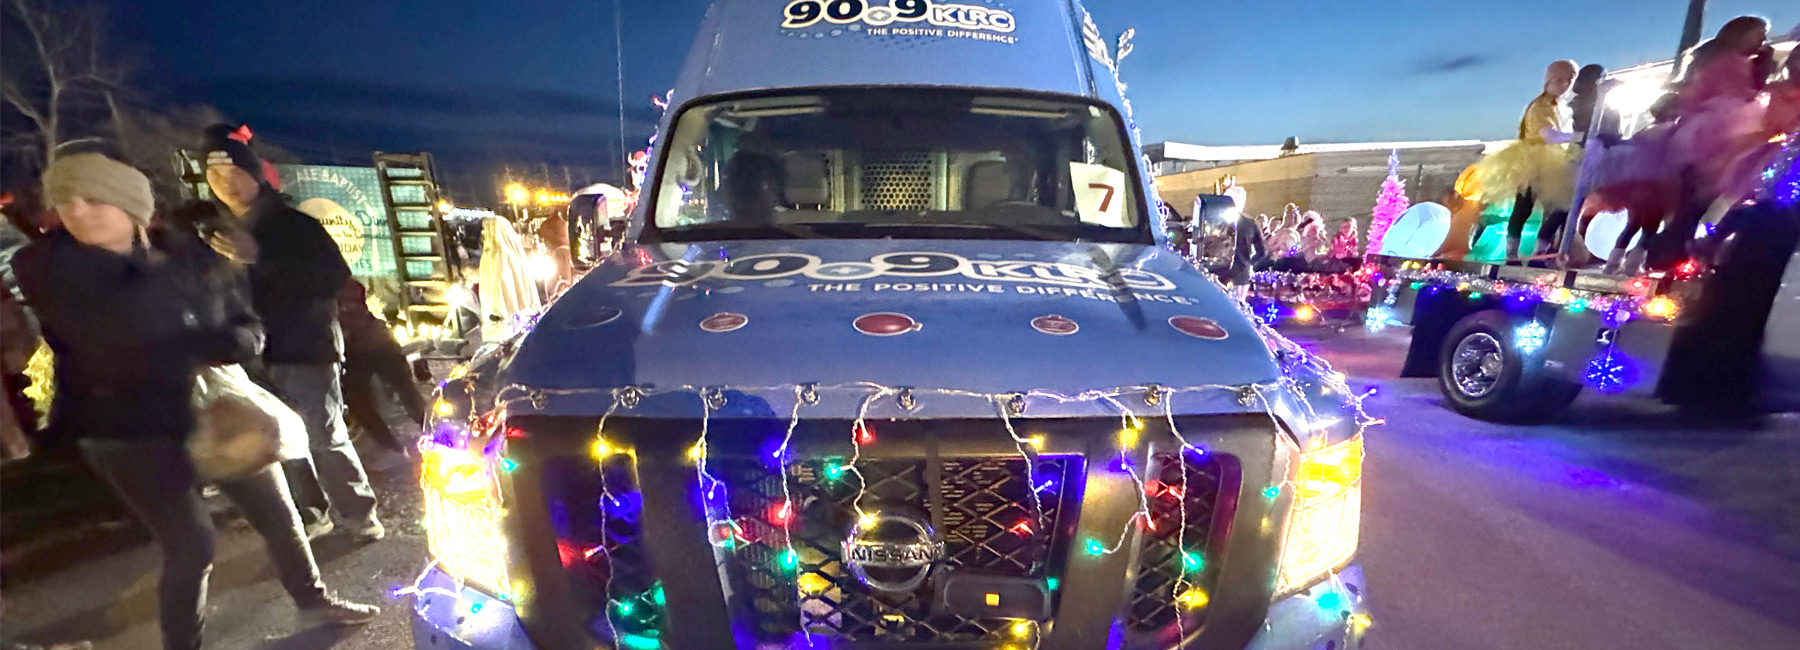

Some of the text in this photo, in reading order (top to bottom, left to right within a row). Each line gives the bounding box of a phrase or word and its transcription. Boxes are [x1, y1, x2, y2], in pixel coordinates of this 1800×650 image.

[932, 6, 1013, 30] KLRC
[866, 28, 1015, 44] THE POSITIVE DIFFERENCE
[1088, 183, 1114, 212] 7
[807, 283, 861, 292] THE
[874, 283, 1004, 293] POSITIVE
[851, 547, 934, 562] NISSAN
